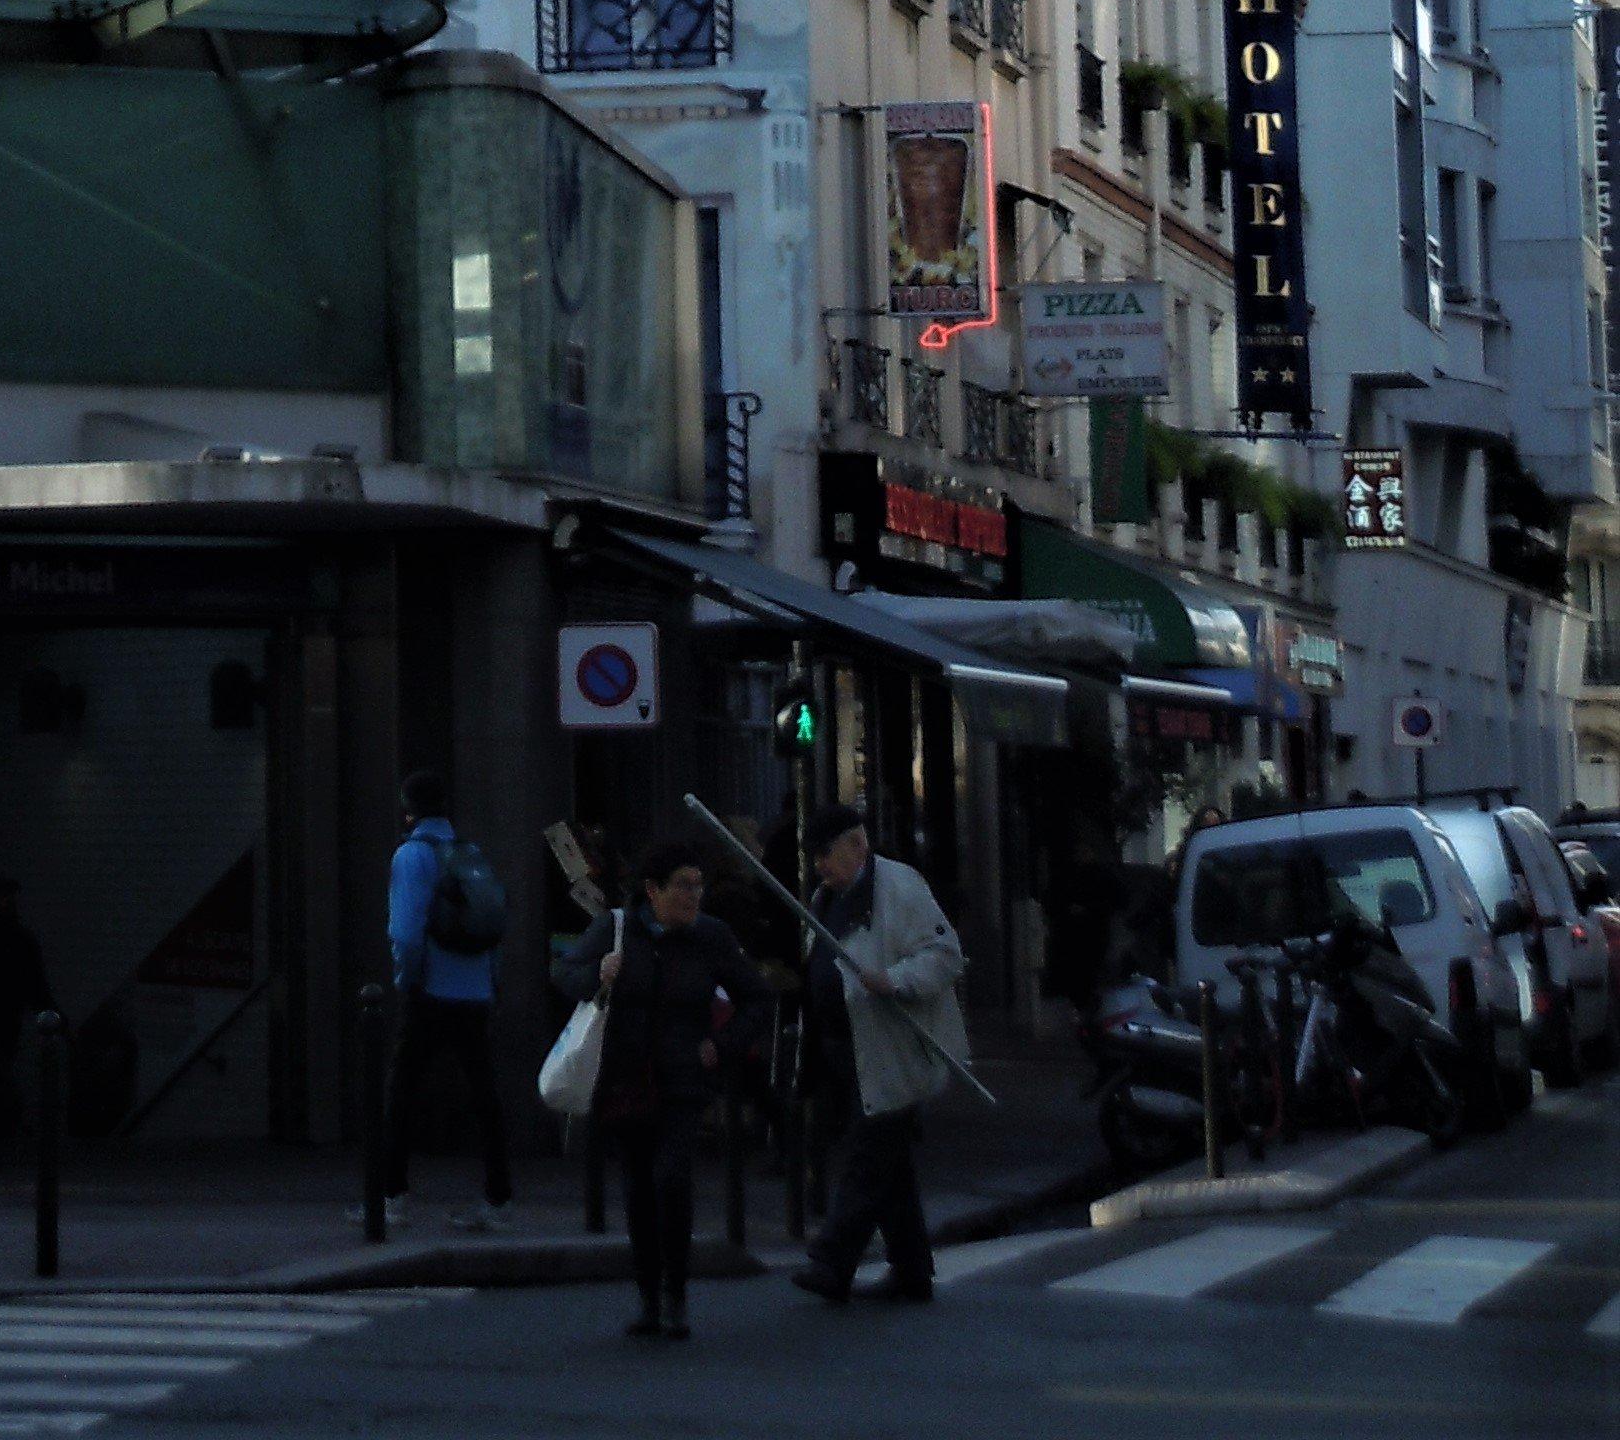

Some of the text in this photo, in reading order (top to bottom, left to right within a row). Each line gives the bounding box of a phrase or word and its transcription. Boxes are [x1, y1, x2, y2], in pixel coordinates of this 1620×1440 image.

[1043, 292, 1145, 317] PIZZA
[1076, 347, 1125, 361] PLATS
[1096, 363, 1107, 375] A
[1076, 376, 1164, 389] EMPORTER
[10, 560, 116, 594] Michel
